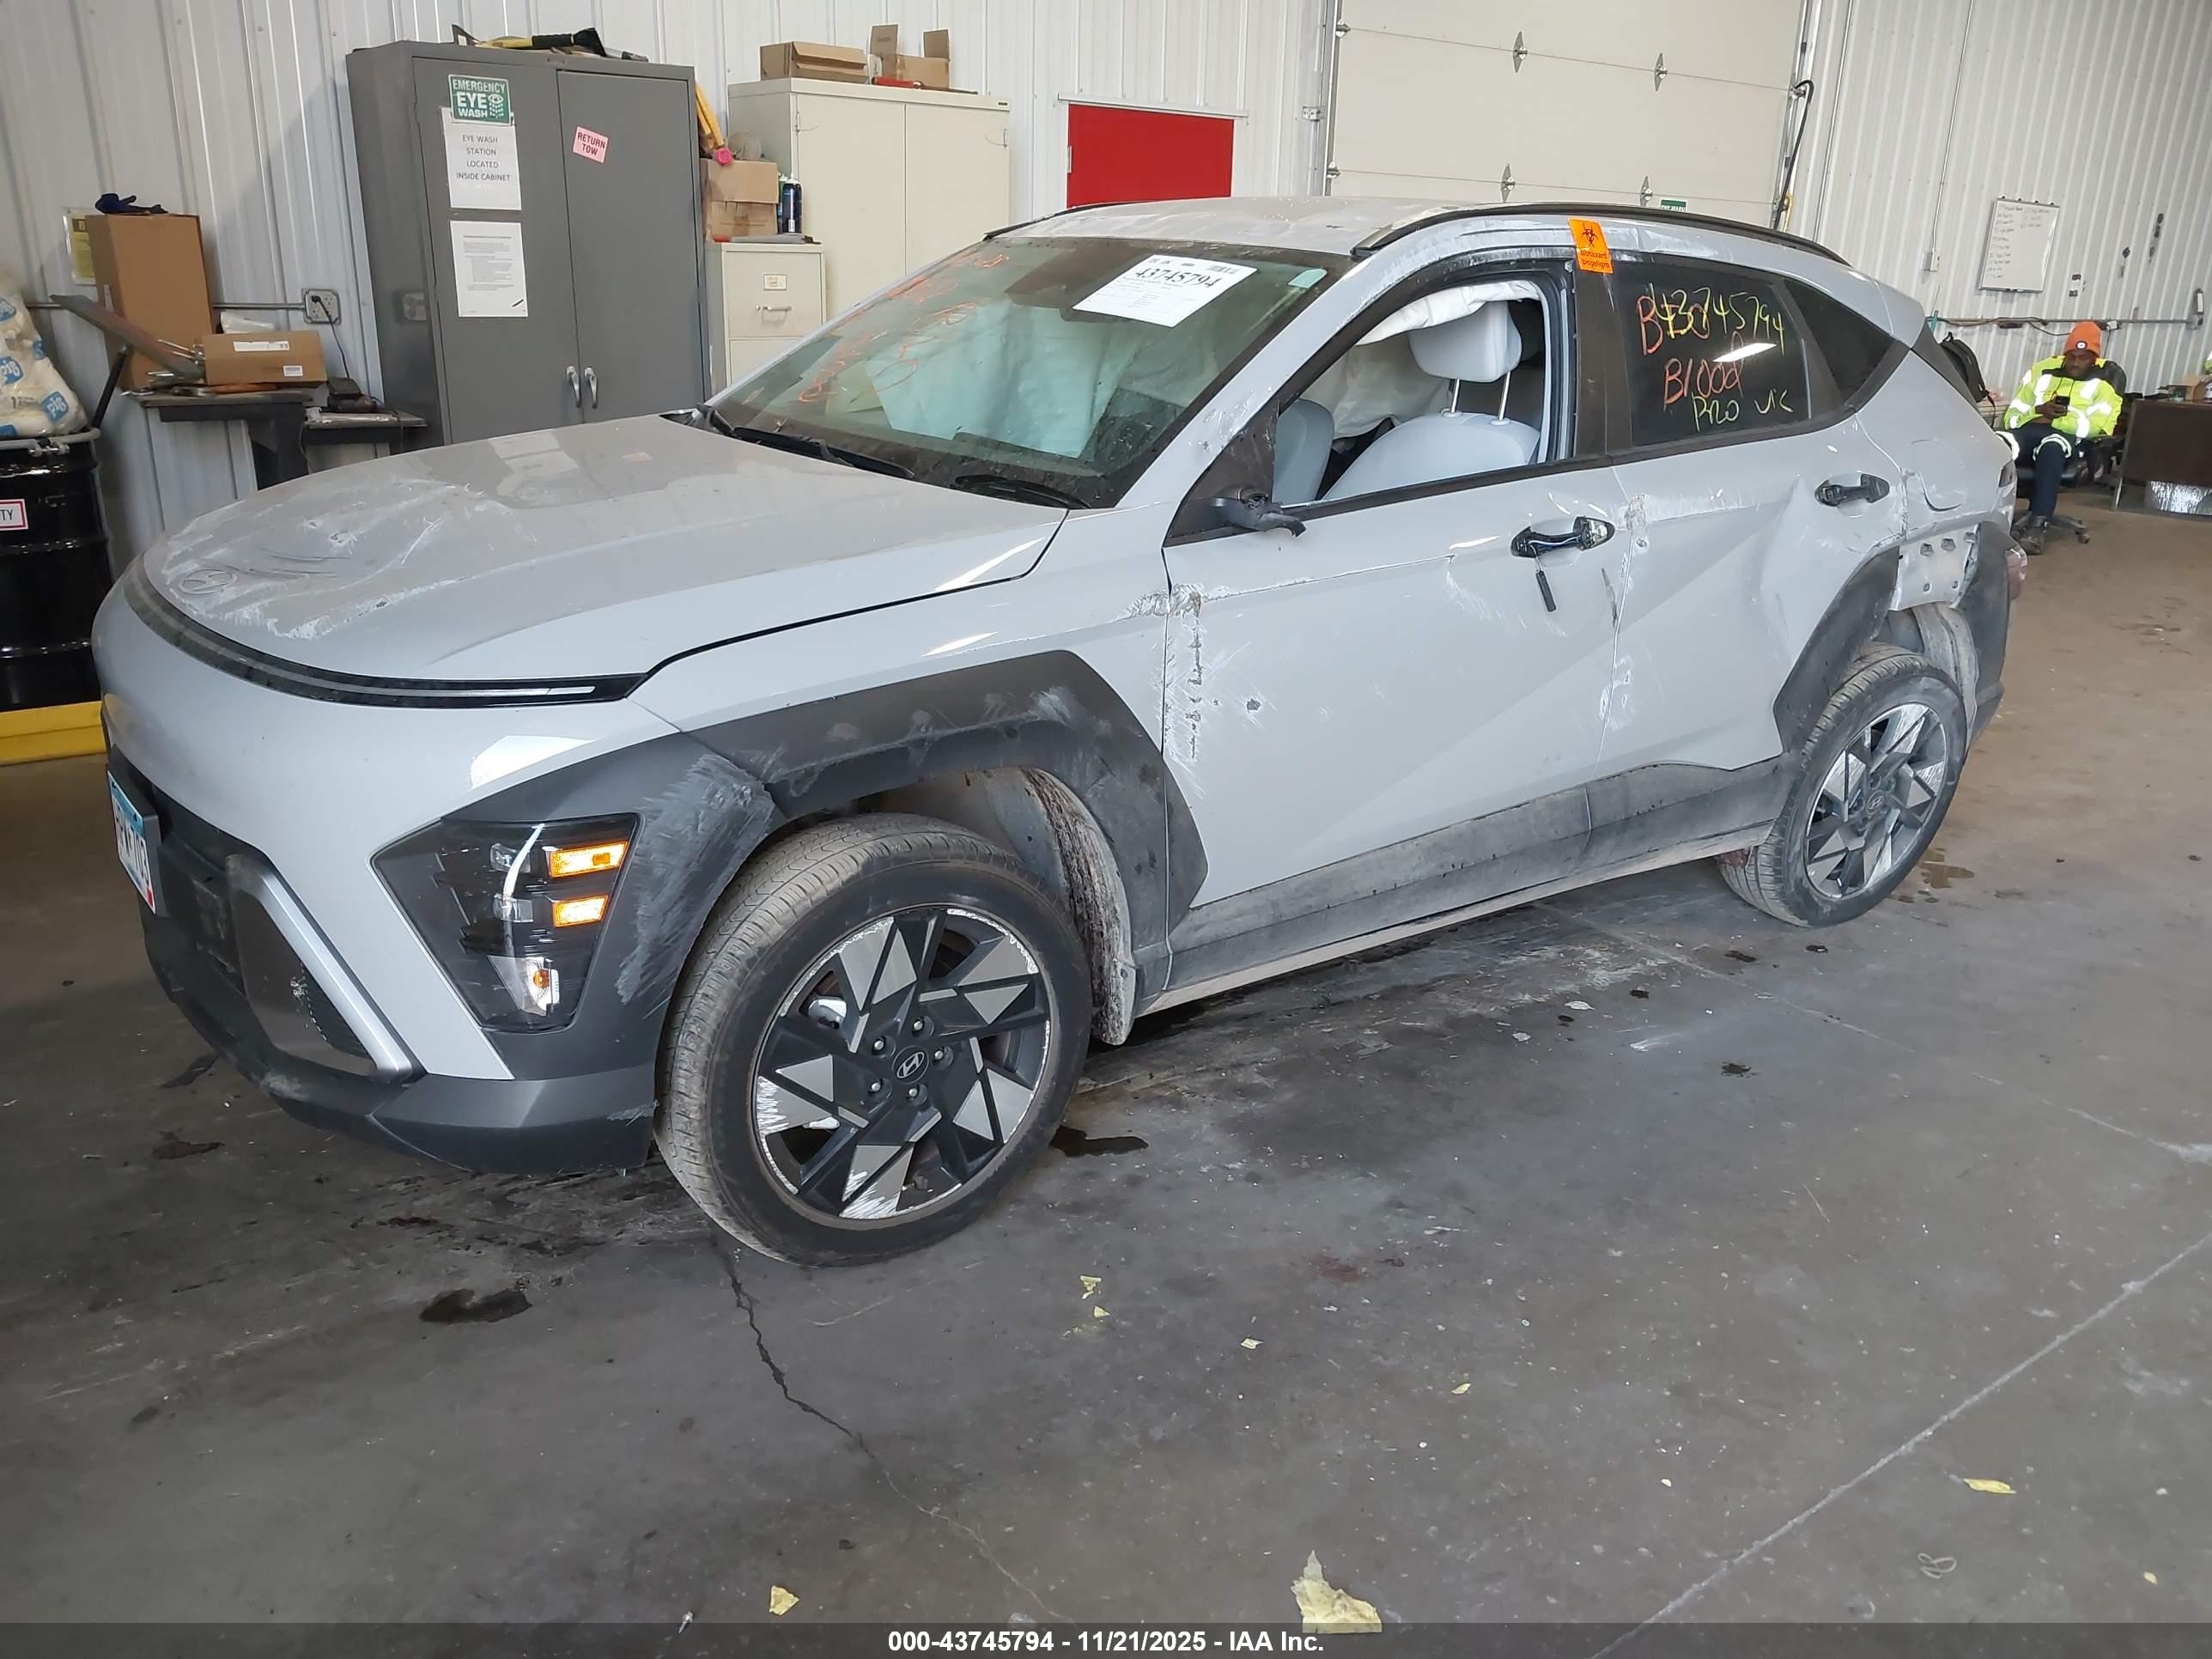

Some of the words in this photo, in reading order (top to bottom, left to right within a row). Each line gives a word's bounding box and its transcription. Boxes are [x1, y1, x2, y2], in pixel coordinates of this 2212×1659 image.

[453, 79, 505, 93] EMERGENCY
[456, 91, 488, 109] EYE
[458, 107, 488, 118] WASH
[462, 134, 474, 143] EYE
[476, 135, 498, 144] WASH
[577, 131, 606, 150] RETURN
[466, 147, 496, 156] STATION
[582, 143, 599, 155] TOW
[466, 160, 498, 169] LOCATED
[456, 172, 479, 180] INSIDE
[481, 173, 510, 182] CABINET
[1135, 267, 1224, 288] 43745794
